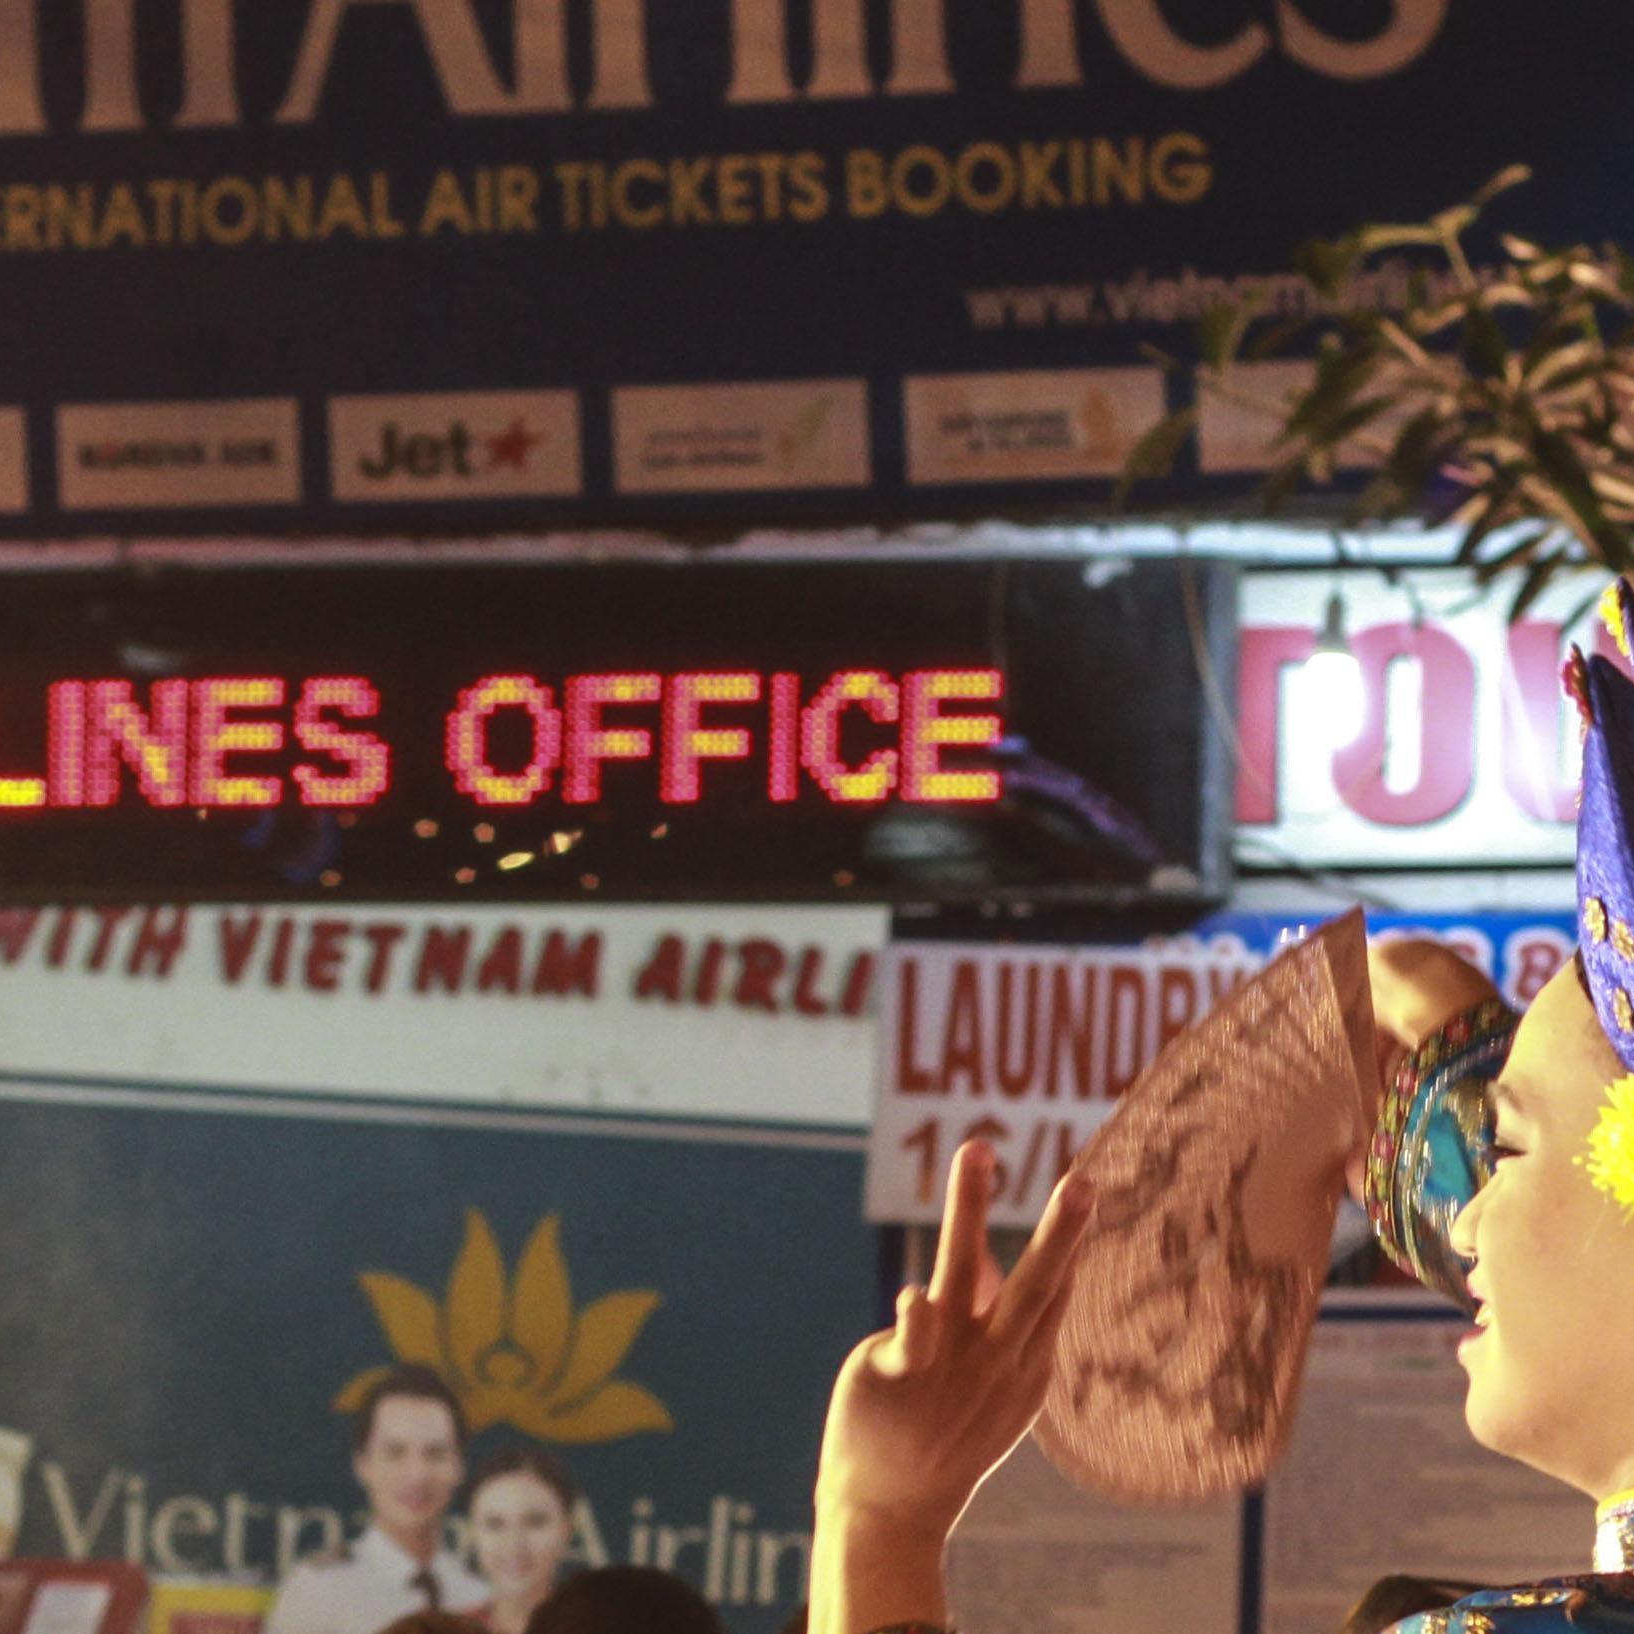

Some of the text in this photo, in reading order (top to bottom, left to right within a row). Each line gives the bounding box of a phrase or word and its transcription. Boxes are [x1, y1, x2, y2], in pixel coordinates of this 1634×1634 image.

[419, 161, 541, 236] AIR
[553, 148, 828, 230] TICKETS
[844, 130, 1213, 220] BOOKING
[359, 420, 473, 480] Jet
[444, 668, 1004, 805] OFFICE
[217, 908, 606, 1001] VIETNAM
